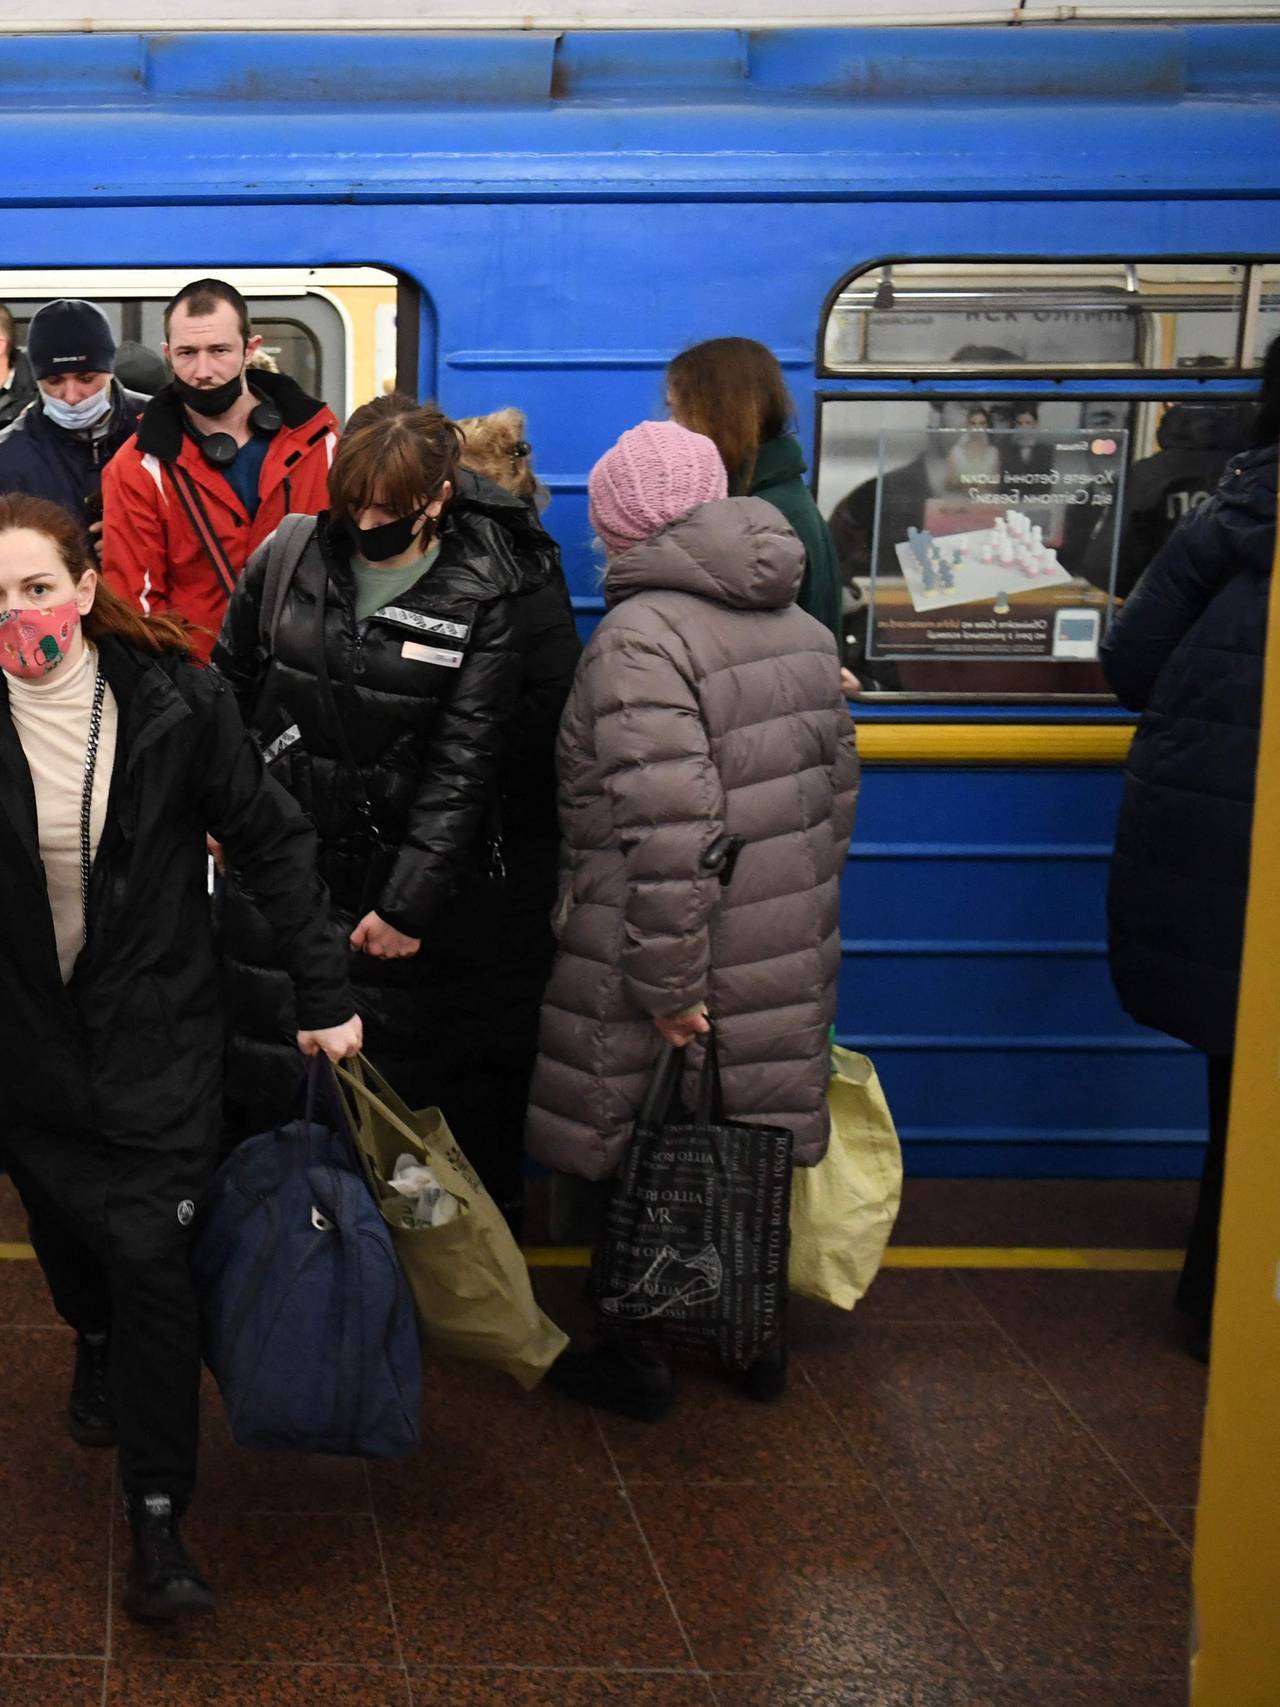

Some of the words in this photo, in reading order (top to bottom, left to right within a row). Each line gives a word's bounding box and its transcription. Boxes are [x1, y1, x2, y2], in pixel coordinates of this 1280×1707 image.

[662, 1190, 704, 1204] VITTO
[770, 1186, 785, 1226] ROSSI
[645, 1206, 673, 1224] VR
[766, 1230, 781, 1275] VITTO
